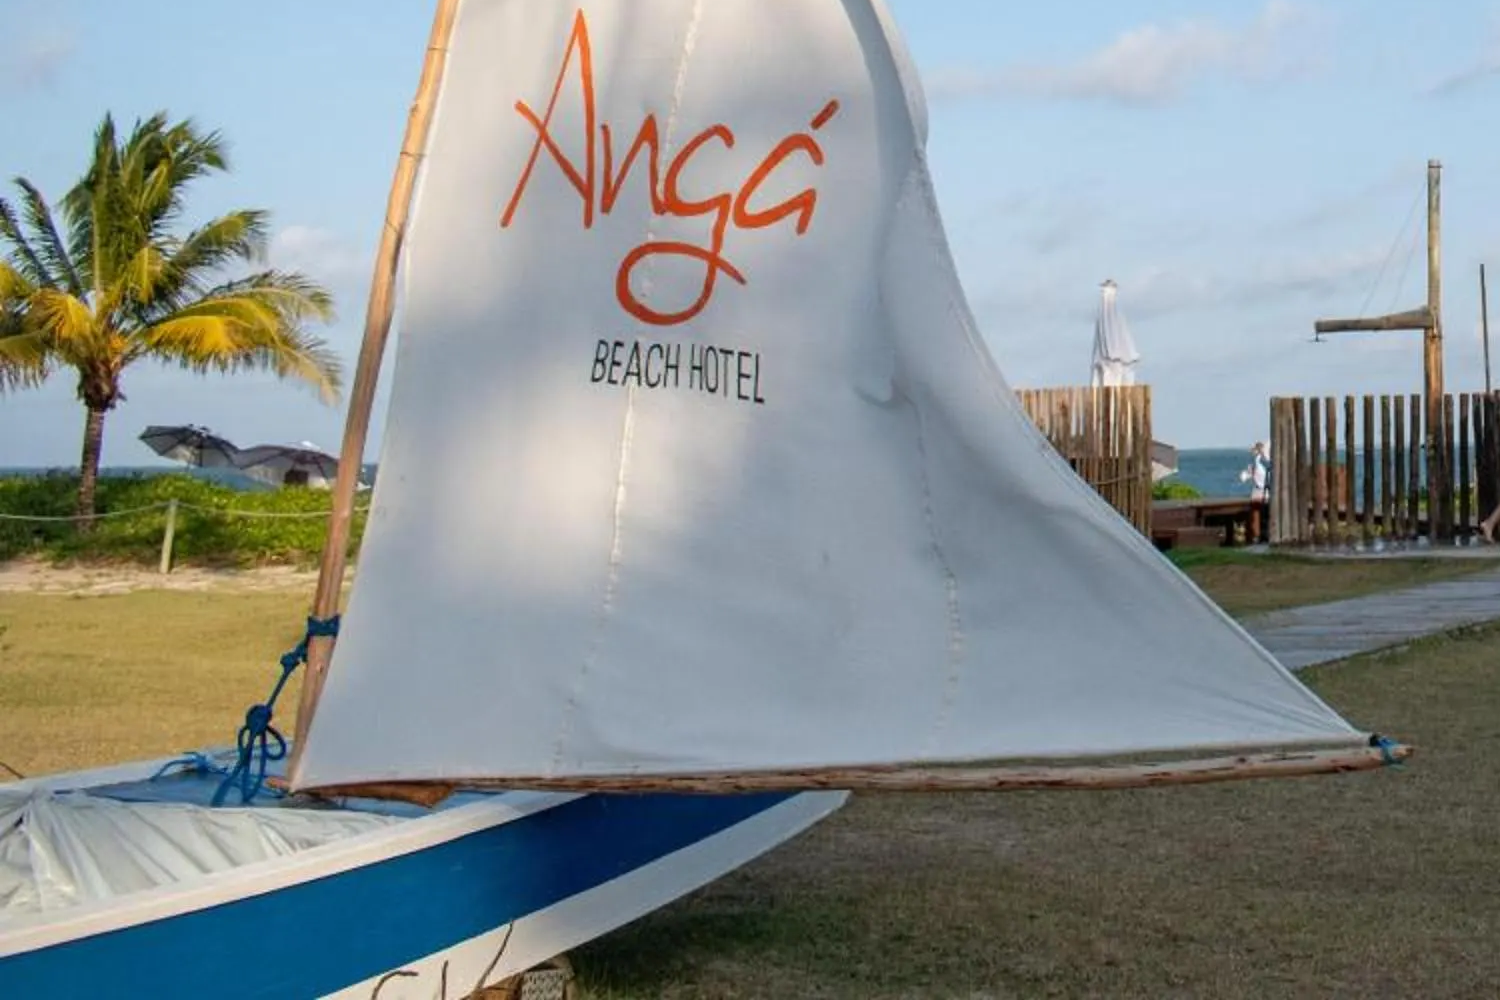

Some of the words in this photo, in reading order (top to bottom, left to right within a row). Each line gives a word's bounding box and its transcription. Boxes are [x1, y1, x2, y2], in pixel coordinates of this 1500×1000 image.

[501, 8, 839, 325] Angá
[591, 339, 681, 388] BEACH
[689, 343, 765, 403] HOTEL
